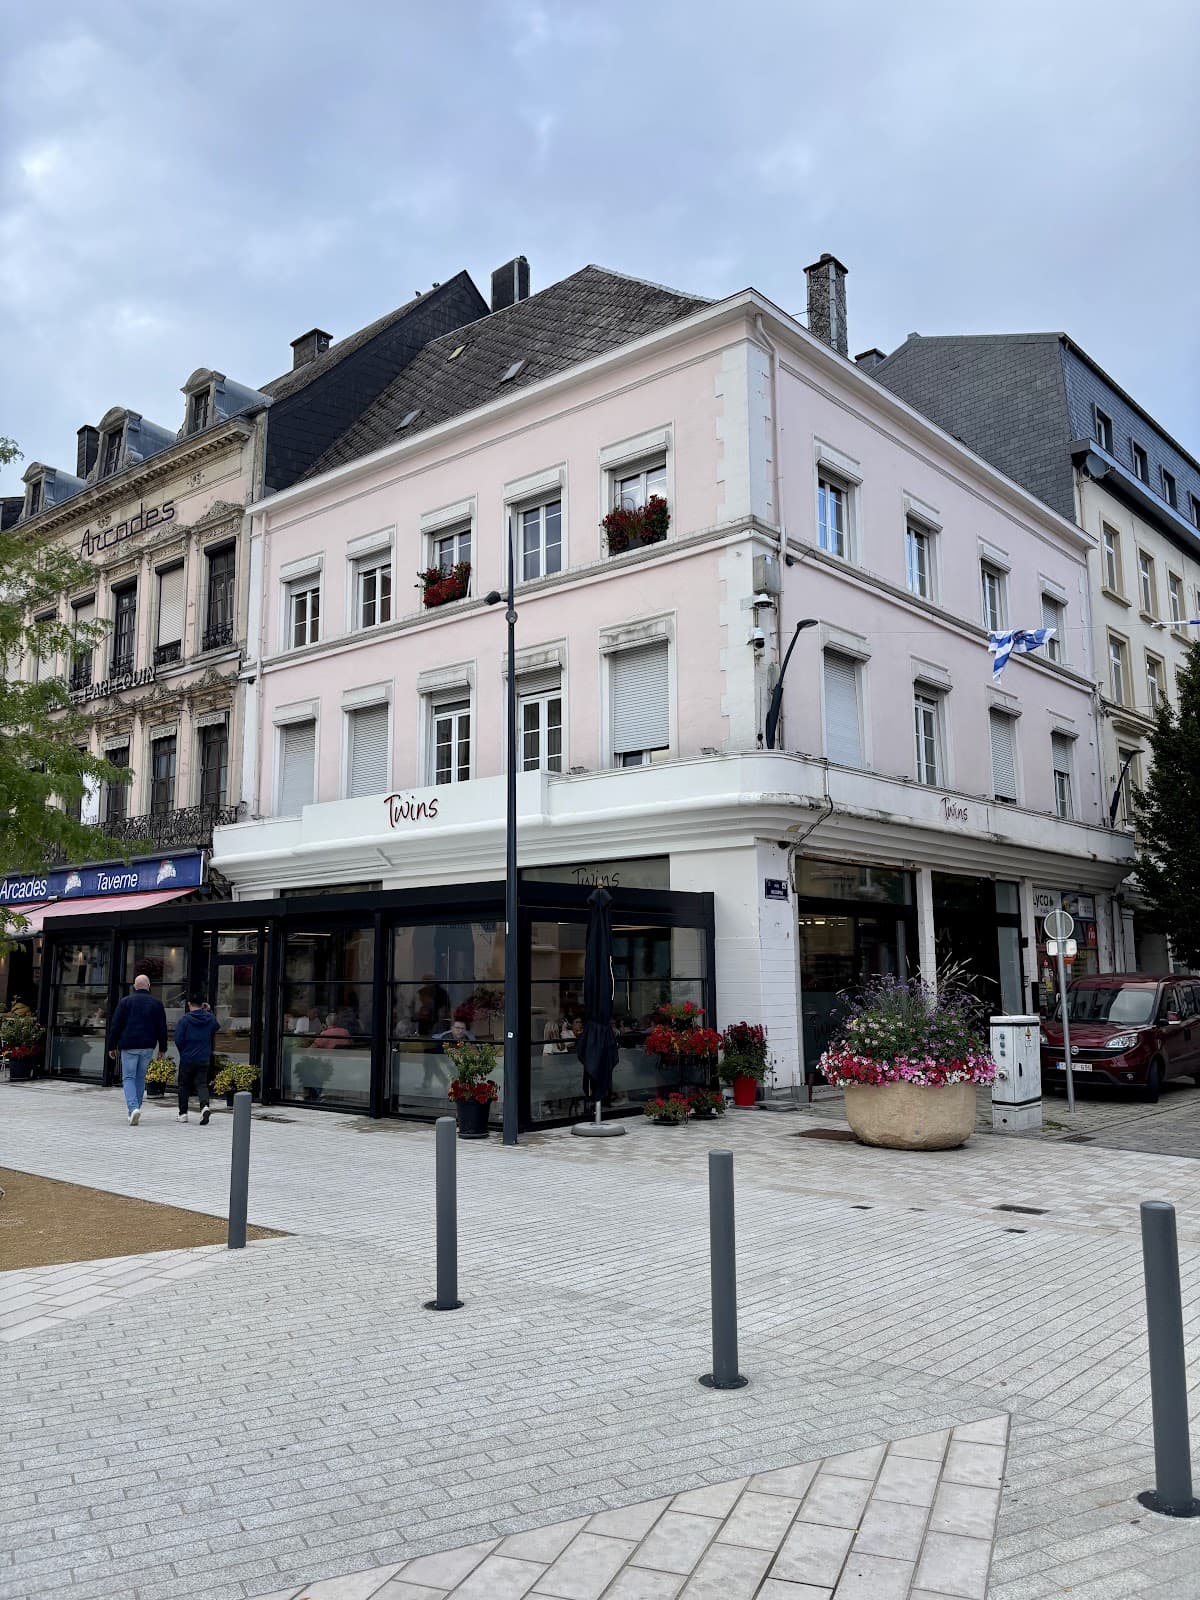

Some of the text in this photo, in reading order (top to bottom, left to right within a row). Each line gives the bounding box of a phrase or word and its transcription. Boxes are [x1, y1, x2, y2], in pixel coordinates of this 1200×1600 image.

[80, 501, 175, 557] Arcades
[384, 794, 438, 828] Twins
[940, 796, 968, 821] Twins
[0, 877, 48, 900] Arcades
[96, 871, 139, 892] Taverne
